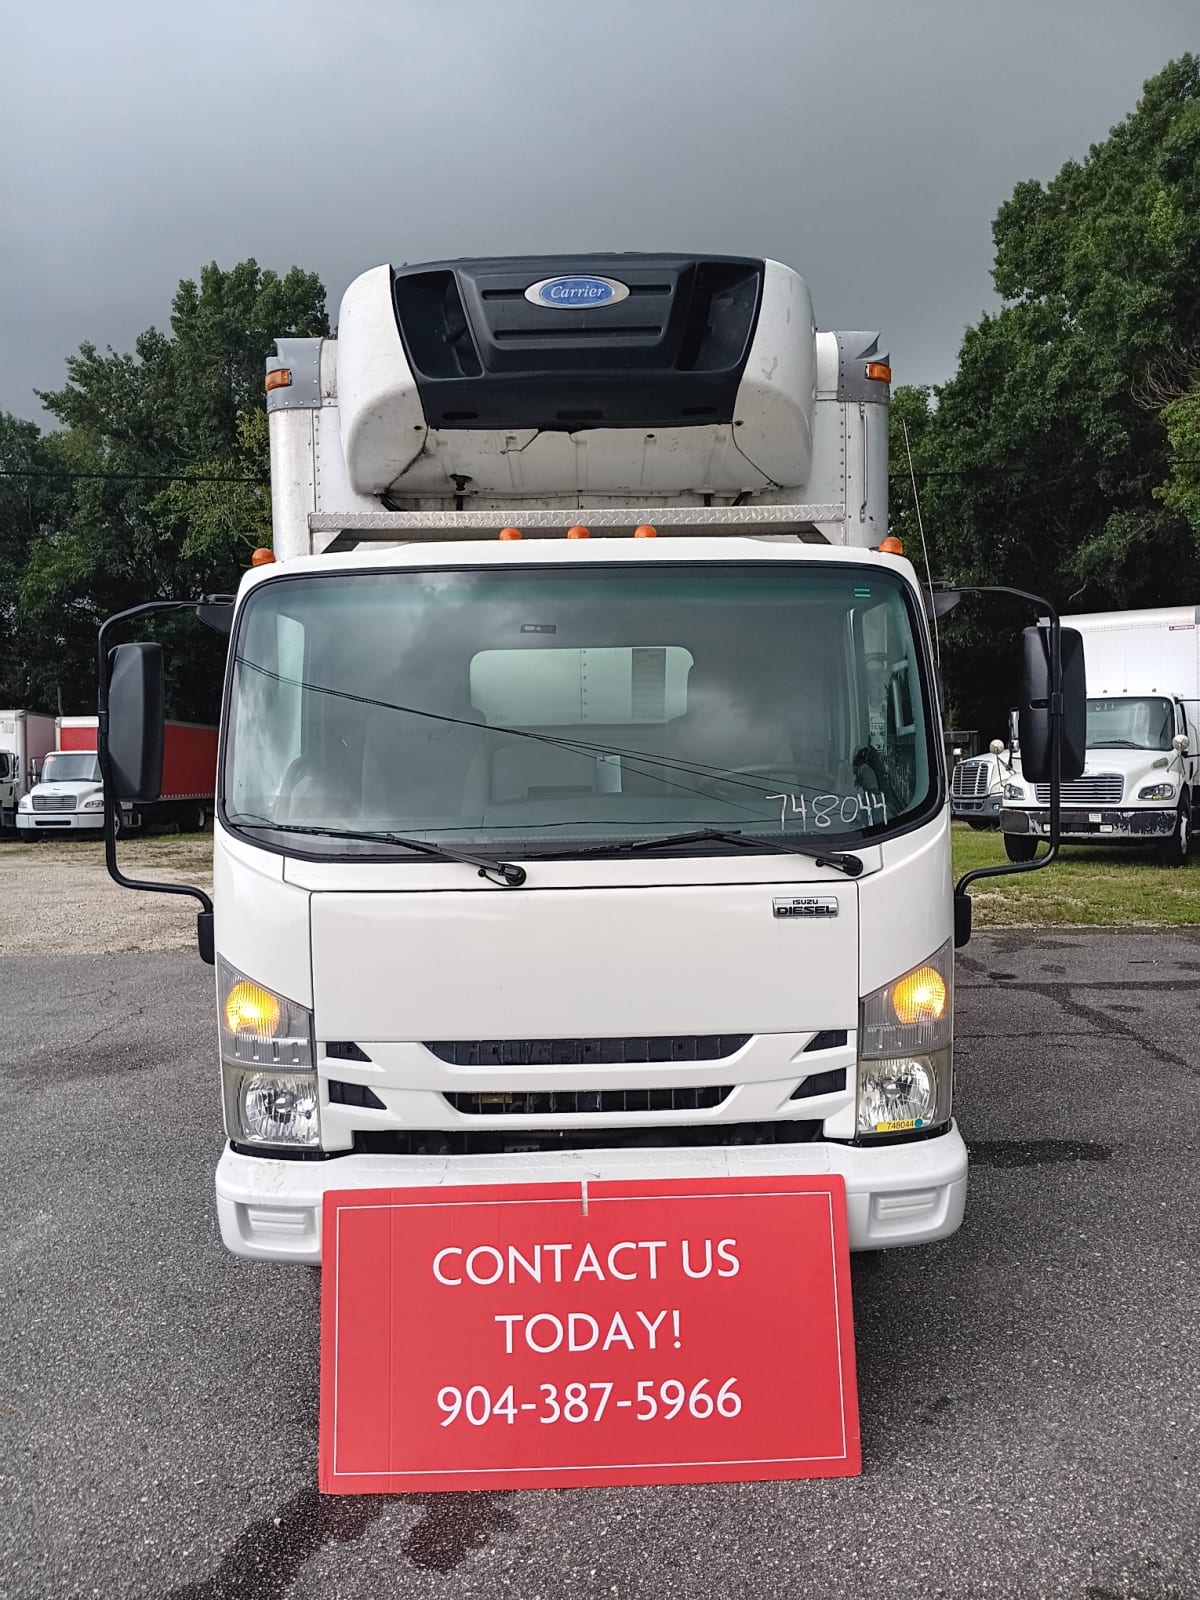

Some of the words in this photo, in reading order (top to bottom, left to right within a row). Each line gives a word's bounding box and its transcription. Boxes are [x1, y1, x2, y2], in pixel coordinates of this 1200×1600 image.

[550, 285, 605, 298] Carrier
[766, 791, 888, 831] 748044
[776, 906, 836, 915] DIESEL
[886, 1120, 914, 1130] 748044
[433, 1241, 666, 1285] CONTACT
[682, 1239, 739, 1278] US
[495, 1310, 681, 1353] TODAY!
[438, 1378, 741, 1426] 904-387-5966
